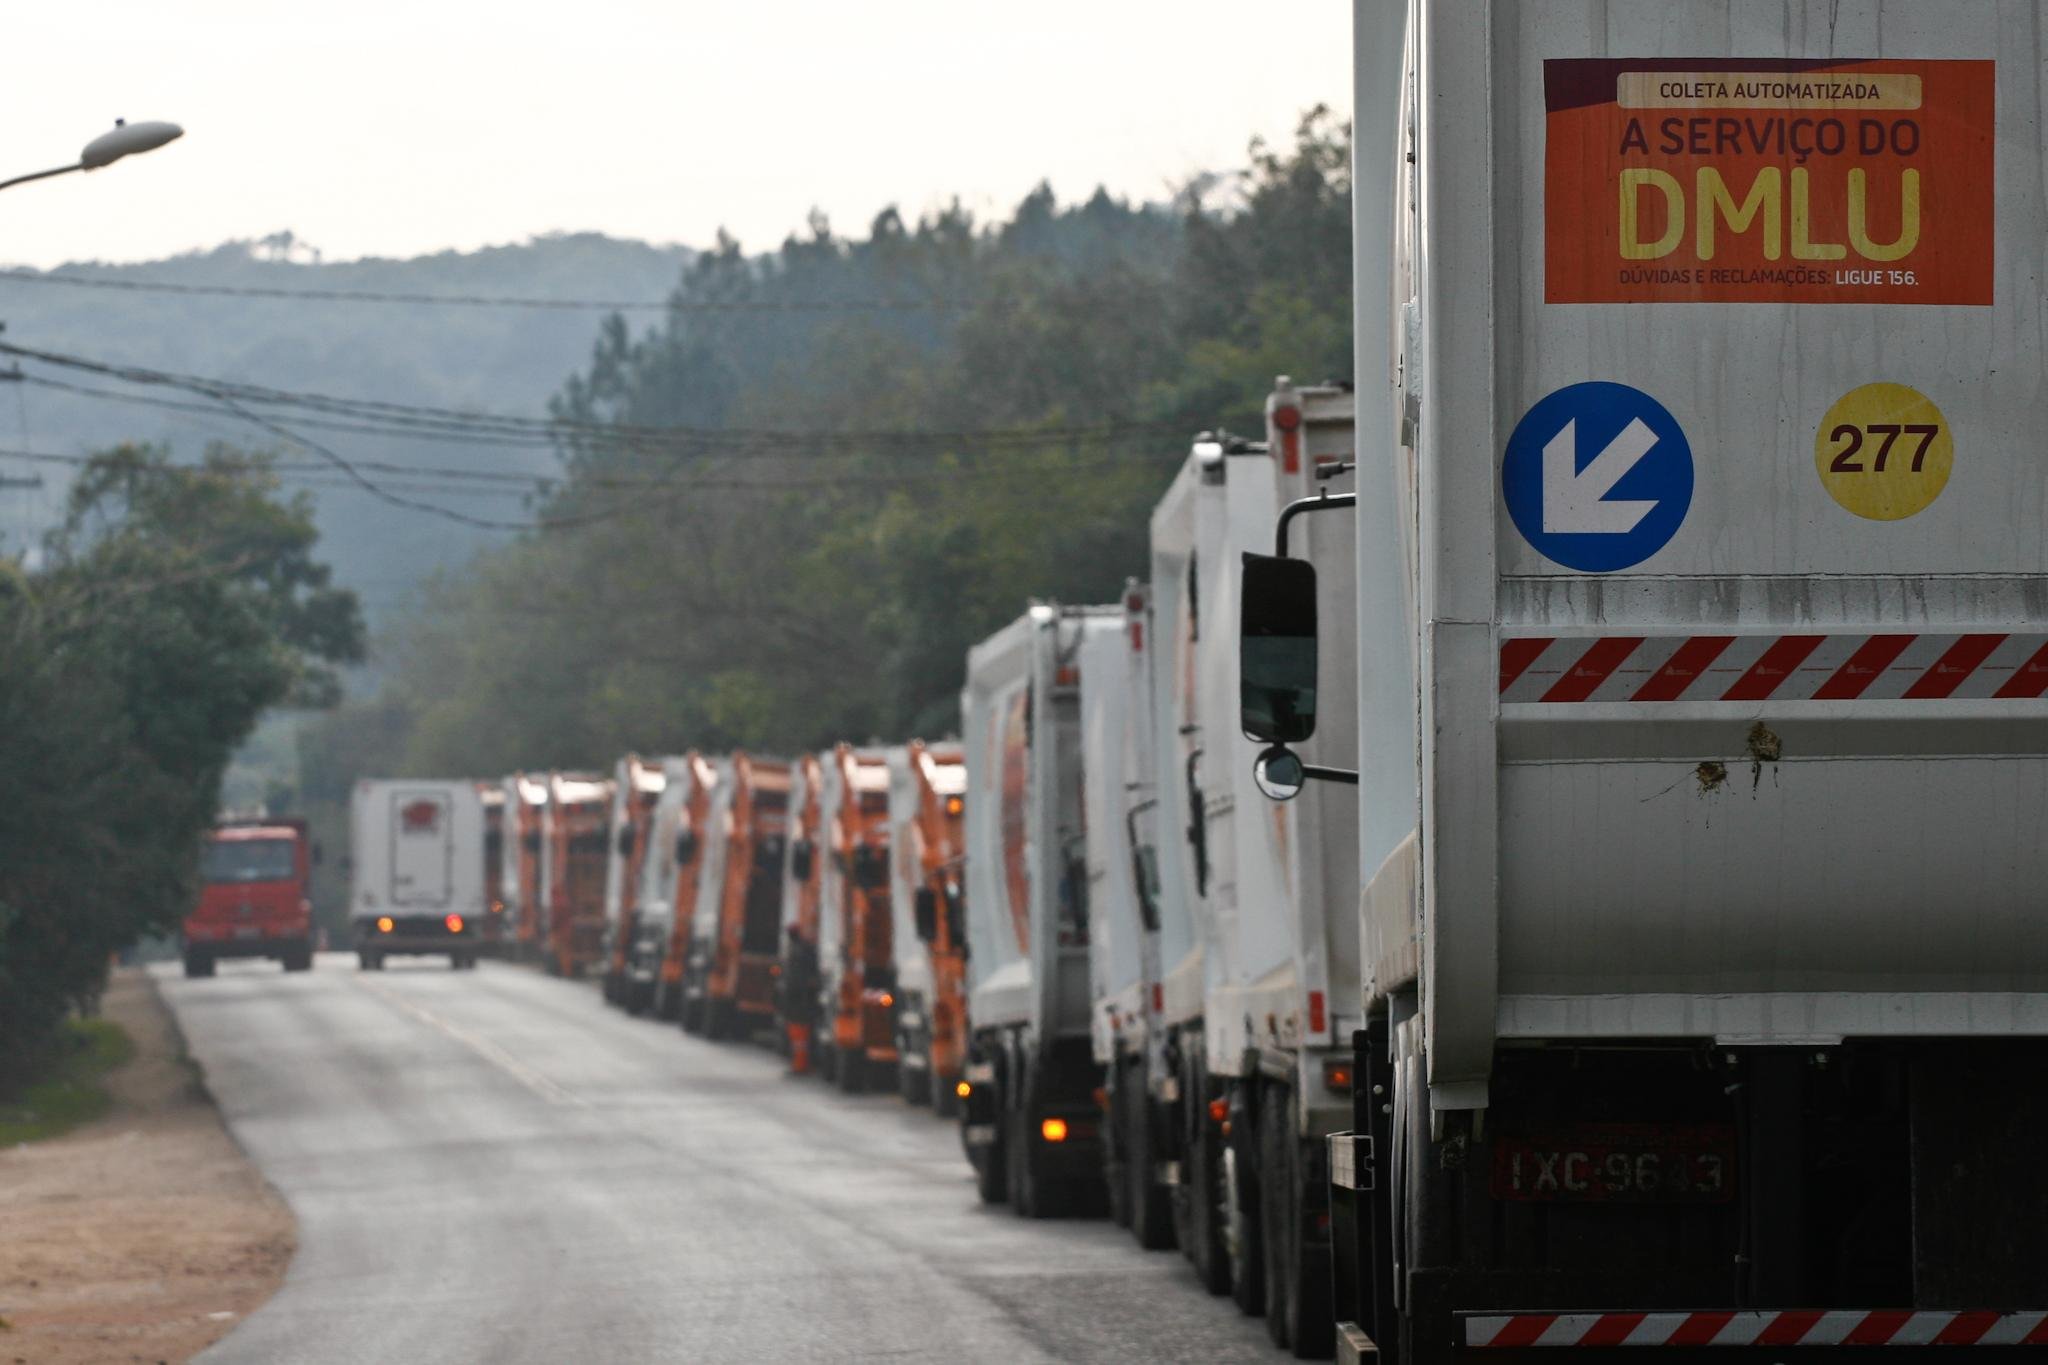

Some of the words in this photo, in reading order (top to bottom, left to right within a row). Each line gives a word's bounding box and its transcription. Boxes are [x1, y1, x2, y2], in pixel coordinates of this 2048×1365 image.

[1660, 82, 1728, 99] COLETA
[1734, 82, 1881, 100] AUTOMATIZADA
[1619, 117, 1650, 155] A
[1660, 117, 1846, 164] SERVIÇO
[1858, 118, 1921, 157] DO
[1619, 166, 1921, 262] DMLU
[1620, 265, 1691, 285] DÚVIDAS
[1695, 269, 1705, 284] E
[1710, 265, 1832, 287] RECLAMAÇÕES:
[1835, 270, 1883, 285] LIGUE
[1887, 270, 1919, 286] 156.
[1829, 424, 1939, 473] 277
